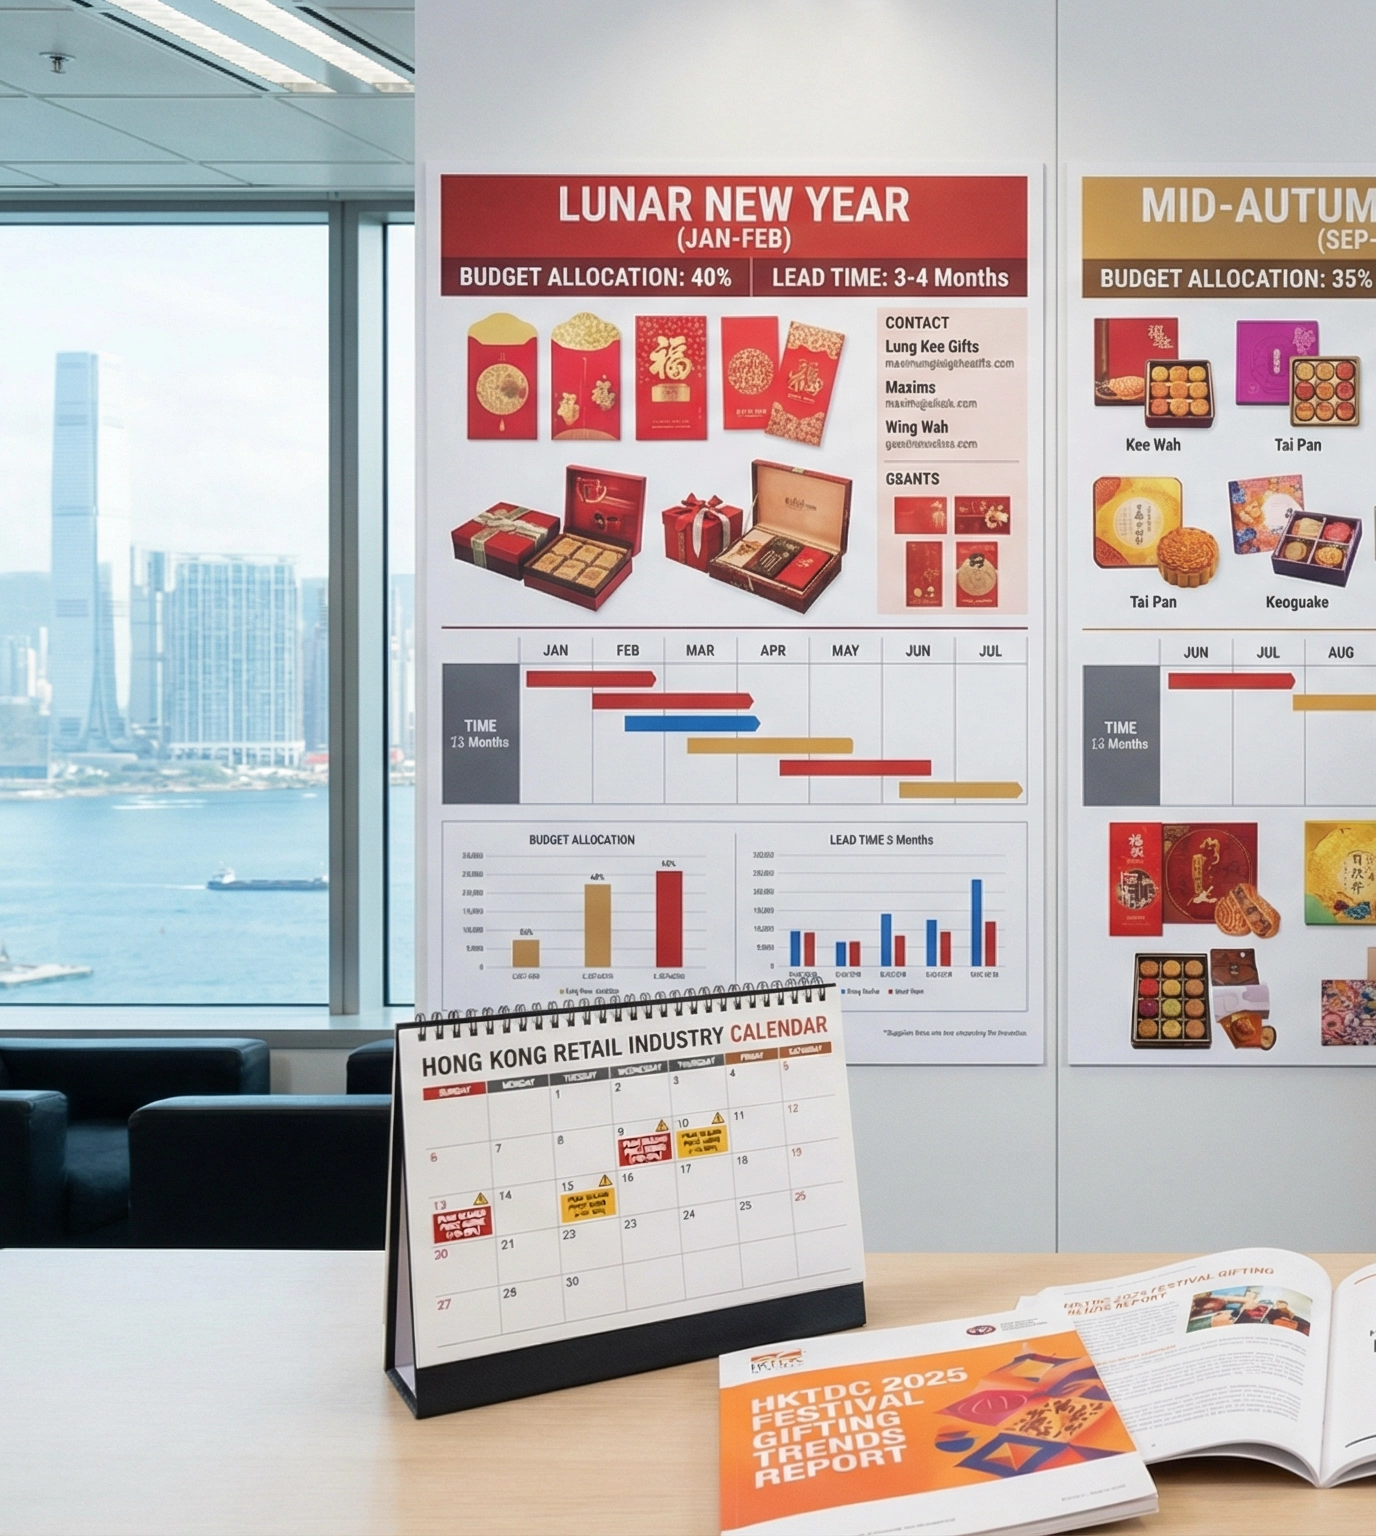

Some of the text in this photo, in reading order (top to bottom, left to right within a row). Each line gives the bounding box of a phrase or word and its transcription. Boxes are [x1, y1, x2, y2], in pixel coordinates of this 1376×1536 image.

[559, 186, 909, 222] LUNAR NEW YEAR
[677, 227, 791, 252] (JAN-FEB)
[460, 266, 732, 287] BUDGET ALLOCATION: 40%
[772, 267, 1009, 288] LEAD TIME: 3-4 Months
[1100, 268, 1374, 289] BUDGET ALLOCATION: 35%
[885, 316, 950, 329] CONTACT
[886, 339, 980, 356] Lung Kee Gifts
[886, 380, 936, 394] Maxims
[886, 420, 948, 436] Wing Wah
[1126, 438, 1181, 452] Kee Wah
[1275, 438, 1322, 452] Tai Pan
[1130, 595, 1177, 609] Tai Pan
[543, 644, 569, 657] JAN
[616, 644, 640, 657] FEB
[686, 644, 715, 657] MAR
[760, 645, 787, 657] APR
[832, 645, 860, 657] MAY
[906, 645, 931, 657] JUN
[979, 645, 1003, 657] JUL
[1184, 647, 1209, 659] JUN
[1257, 647, 1280, 659] JUL
[1328, 647, 1355, 659] AUG
[464, 719, 497, 732] TIME
[1104, 721, 1137, 734] TIME
[468, 736, 510, 748] Months
[529, 834, 635, 845] BUDGET ALLOCATION
[830, 834, 857, 845] LEAD
[859, 834, 884, 845] TIME
[422, 1015, 828, 1077] HONG KONG RETAIL INDUSTRY CALENDAR
[729, 1069, 736, 1077] 4
[673, 1076, 679, 1085] 3
[615, 1083, 621, 1092] 2
[555, 1090, 560, 1099] 1
[788, 1104, 799, 1113] 12
[734, 1111, 744, 1120] 11
[678, 1118, 689, 1128] 10
[618, 1127, 624, 1136] 9
[558, 1135, 564, 1145] 8
[495, 1144, 502, 1153] 7
[737, 1156, 748, 1165] 18
[681, 1164, 691, 1174] 17
[622, 1173, 634, 1182] 16
[562, 1181, 574, 1191] 15
[500, 1191, 512, 1200] 14
[683, 1210, 695, 1220] 24
[624, 1219, 637, 1229] 23
[562, 1230, 576, 1240] 23
[501, 1239, 514, 1250] 21
[434, 1249, 448, 1260] 20
[566, 1277, 579, 1287] 30
[437, 1299, 451, 1310] 27
[751, 1367, 968, 1414] HKTDC 2025
[752, 1391, 924, 1431] FESTIVAL
[753, 1411, 900, 1449] GIFTING
[753, 1428, 906, 1467] TRENDS
[755, 1445, 907, 1489] REPORT
